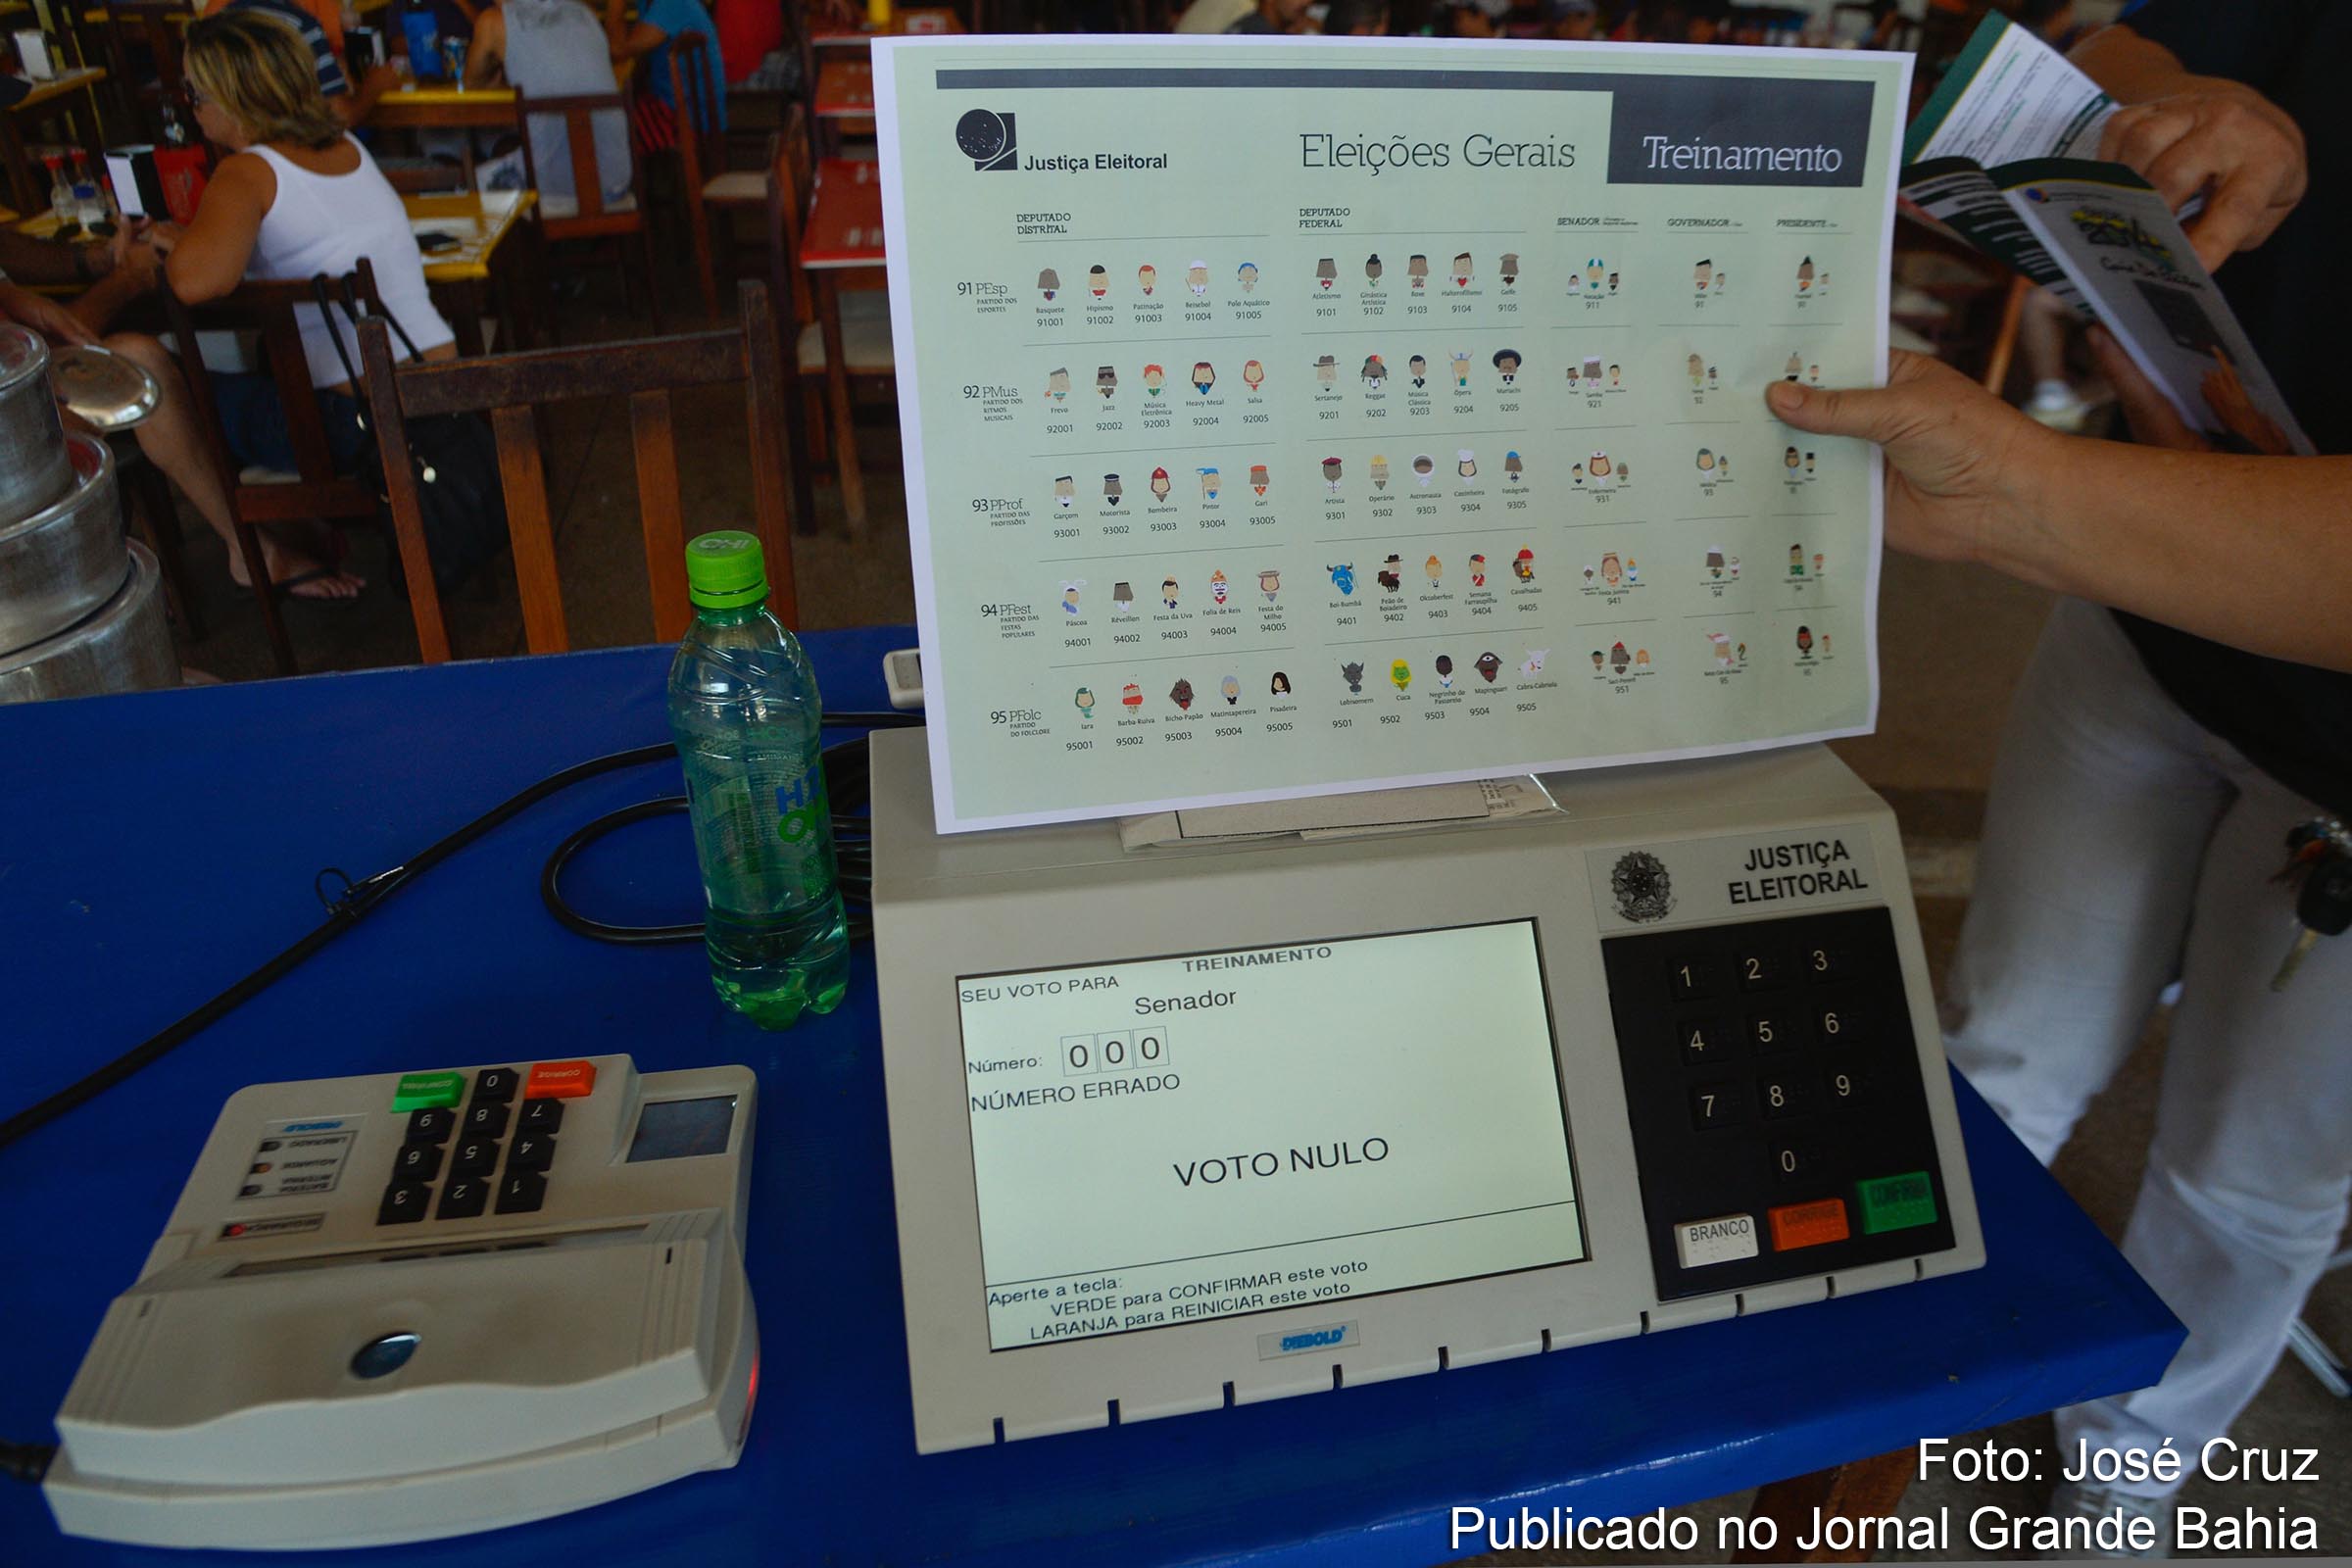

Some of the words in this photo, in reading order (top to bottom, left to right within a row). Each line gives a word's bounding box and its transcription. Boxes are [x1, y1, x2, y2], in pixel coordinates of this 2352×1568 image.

[1299, 133, 1449, 176] Eleições
[1463, 134, 1575, 168] Gerais
[1642, 136, 1841, 172] Treinamento
[1024, 155, 1089, 173] Justiça
[1096, 153, 1167, 170] Eleitoral
[1016, 213, 1071, 222] DEPUTADO
[1299, 208, 1350, 217] DEPUTADO
[1017, 223, 1067, 234] DISTRITAL
[1298, 220, 1343, 228] FEDERAL
[957, 282, 972, 296] 91
[975, 282, 1007, 297] PEsp
[1586, 301, 1599, 310] 911
[1236, 311, 1261, 319] 91005
[1316, 308, 1336, 317] 9101
[1363, 307, 1384, 316] 9102
[1087, 316, 1113, 324] 91002
[1135, 314, 1162, 323] 91003
[1185, 313, 1211, 321] 91004
[1037, 318, 1063, 327] 91001
[963, 385, 980, 399] 92
[982, 385, 1018, 398] PMus
[1409, 407, 1430, 416] 9203
[1499, 403, 1520, 412] 9205
[1319, 411, 1339, 419] 9201
[1366, 409, 1386, 417] 9202
[1144, 419, 1170, 428] 92003
[1193, 416, 1219, 426] 92004
[1243, 414, 1269, 423] 92005
[1047, 424, 1073, 433] 92001
[1096, 421, 1122, 431] 92002
[972, 499, 989, 513] 93
[990, 498, 1023, 512] PProf
[1507, 500, 1527, 509] 9305
[1372, 509, 1393, 517] 9302
[1416, 506, 1437, 514] 9303
[1250, 515, 1276, 525] 93005
[1325, 512, 1345, 520] 9301
[1151, 522, 1177, 532] 93003
[1200, 519, 1226, 528] 93004
[1054, 528, 1080, 538] 93001
[1102, 525, 1129, 535] 93002
[981, 604, 998, 617] 94
[1000, 604, 1031, 615] PFest
[1428, 610, 1448, 618] 9403
[1472, 607, 1492, 615] 9404
[1337, 616, 1356, 626] 9401
[1384, 613, 1403, 622] 9402
[1210, 627, 1237, 636] 94004
[1260, 622, 1287, 632] 94005
[1113, 634, 1141, 644] 94002
[1161, 630, 1188, 640] 94003
[1064, 638, 1091, 648] 94001
[1469, 708, 1490, 716] 9504
[1516, 703, 1537, 711] 9505
[991, 710, 1006, 724] 95
[1009, 709, 1042, 722] PFolc
[1380, 714, 1400, 724] 9502
[1425, 710, 1446, 720] 9503
[1266, 722, 1293, 732] 95005
[1332, 719, 1352, 728] 9501
[1164, 731, 1192, 742] 95003
[1215, 727, 1243, 737] 95004
[1066, 741, 1093, 751] 95001
[1116, 736, 1144, 747] 95002
[1744, 840, 1850, 871] JUSTIÇA
[1728, 868, 1868, 905] ELEITORAL
[1182, 945, 1333, 973] TREINAMENTO
[1813, 950, 1828, 970] 3
[1746, 958, 1762, 979] 2
[1681, 966, 1690, 987] 1
[961, 988, 1001, 1003] SEU
[1006, 981, 1061, 998] VOTO
[1068, 976, 1119, 992] PARA
[1135, 990, 1236, 1014] Senador
[1825, 1012, 1839, 1034] 6
[1759, 1021, 1773, 1042] 5
[1690, 1030, 1704, 1051] 4
[968, 1057, 1042, 1074] Número:
[1069, 1045, 1088, 1068] 0
[1105, 1041, 1124, 1064] 0
[1142, 1037, 1159, 1059] 0
[486, 1076, 498, 1088] 0
[1837, 1075, 1850, 1096] 9
[971, 1086, 1075, 1111] NÚMERO
[1083, 1074, 1180, 1099] ERRADO
[1770, 1085, 1784, 1106] 8
[530, 1105, 543, 1117] 7
[1701, 1095, 1714, 1117] 7
[419, 1113, 432, 1127] 9
[476, 1108, 488, 1122] 8
[466, 1146, 477, 1158] 5
[520, 1141, 533, 1154] 4
[408, 1151, 420, 1164] 6
[1173, 1152, 1278, 1186] VOTO
[1290, 1138, 1389, 1172] NULO
[1782, 1151, 1795, 1172] 0
[511, 1180, 521, 1193] 1
[453, 1185, 466, 1199] 2
[394, 1191, 408, 1204] 3
[1690, 1219, 1748, 1242] BRANCO
[988, 1289, 1050, 1308] Aperte
[1056, 1286, 1066, 1297] a
[1073, 1278, 1122, 1294] tecla:
[1051, 1296, 1116, 1316] VERDE
[1122, 1289, 1163, 1310] para
[1168, 1272, 1284, 1300] CONFIRMAR
[1288, 1268, 1325, 1282] este
[1330, 1261, 1368, 1276] voto
[1030, 1316, 1119, 1341] LARANJA
[1125, 1310, 1165, 1330] para
[1170, 1294, 1264, 1321] REINICIAR
[1270, 1290, 1306, 1303] este
[1313, 1284, 1350, 1298] voto
